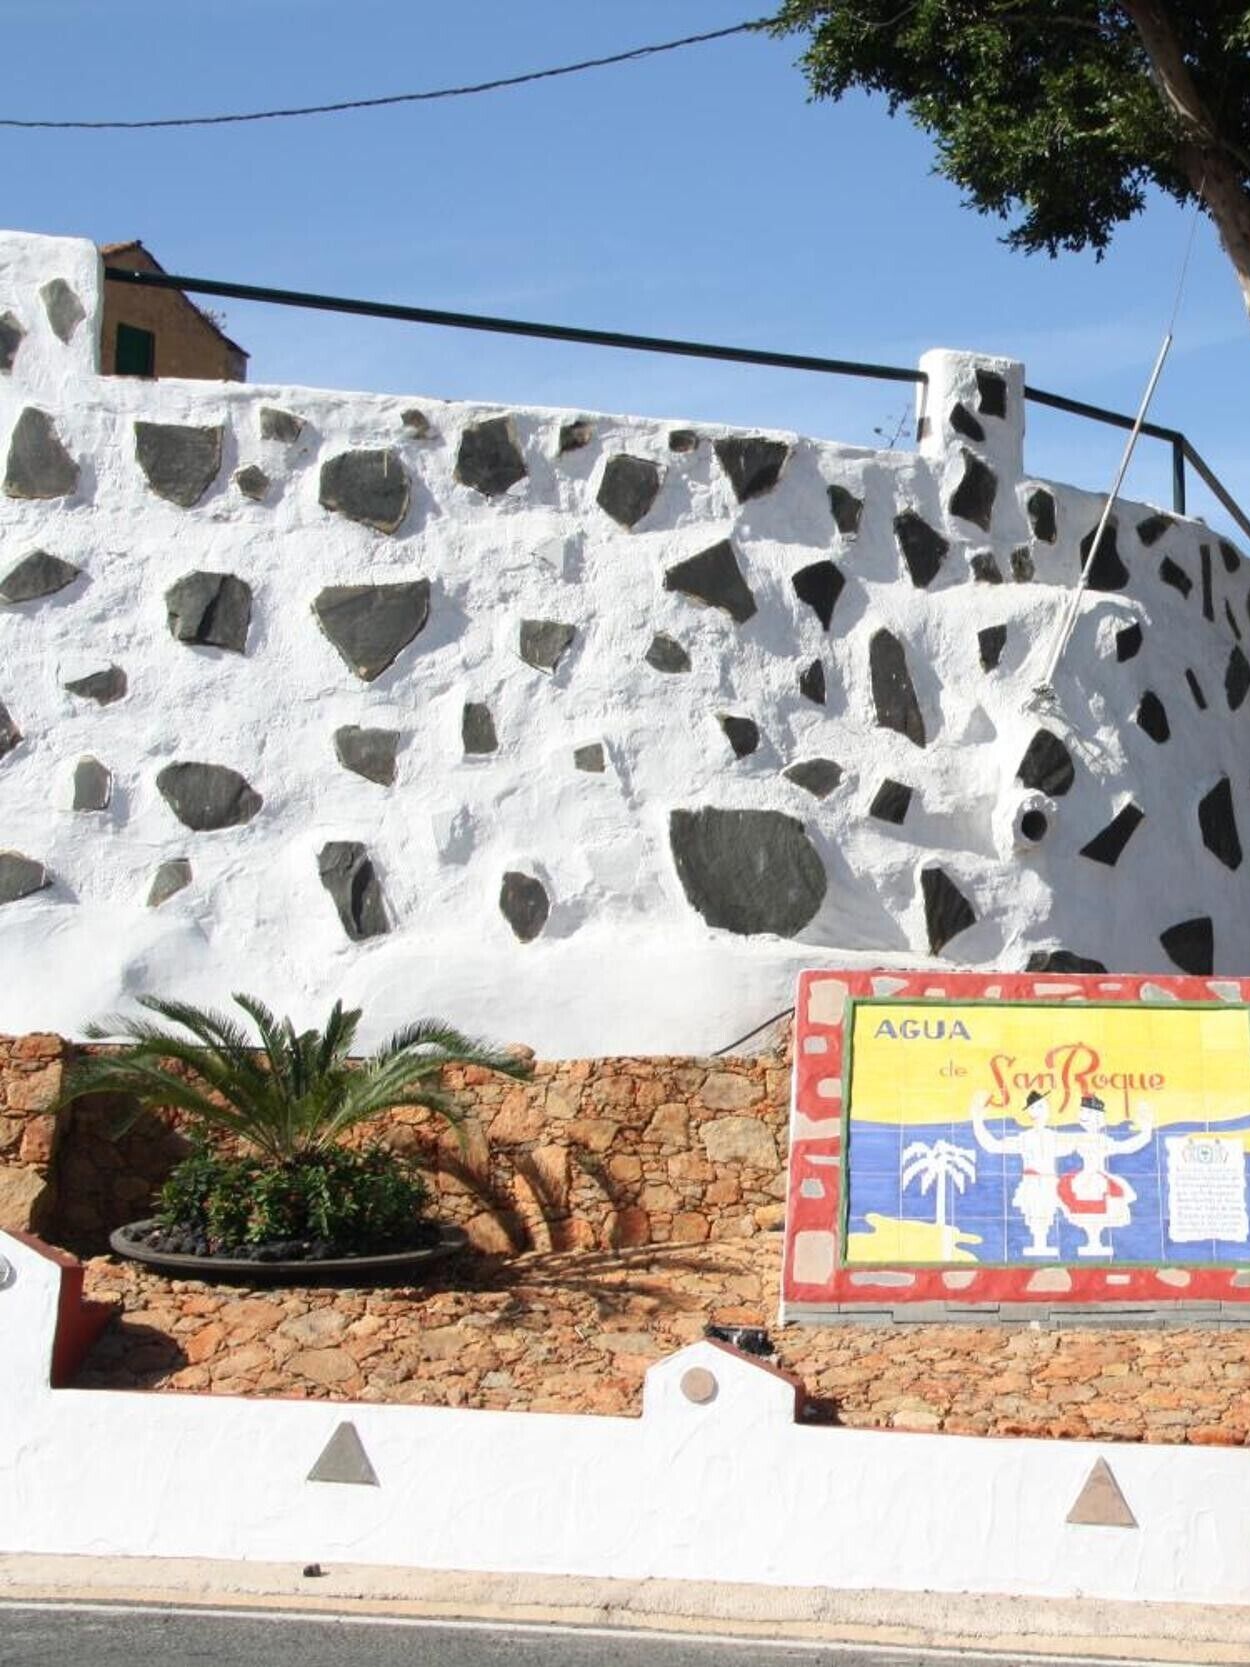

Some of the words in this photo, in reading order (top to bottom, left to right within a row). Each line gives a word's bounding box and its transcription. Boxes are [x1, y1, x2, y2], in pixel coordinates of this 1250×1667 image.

[874, 1019, 971, 1041] AGUA
[939, 1060, 968, 1078] de
[984, 1054, 1056, 1108] San
[1045, 1041, 1166, 1119] Roque
